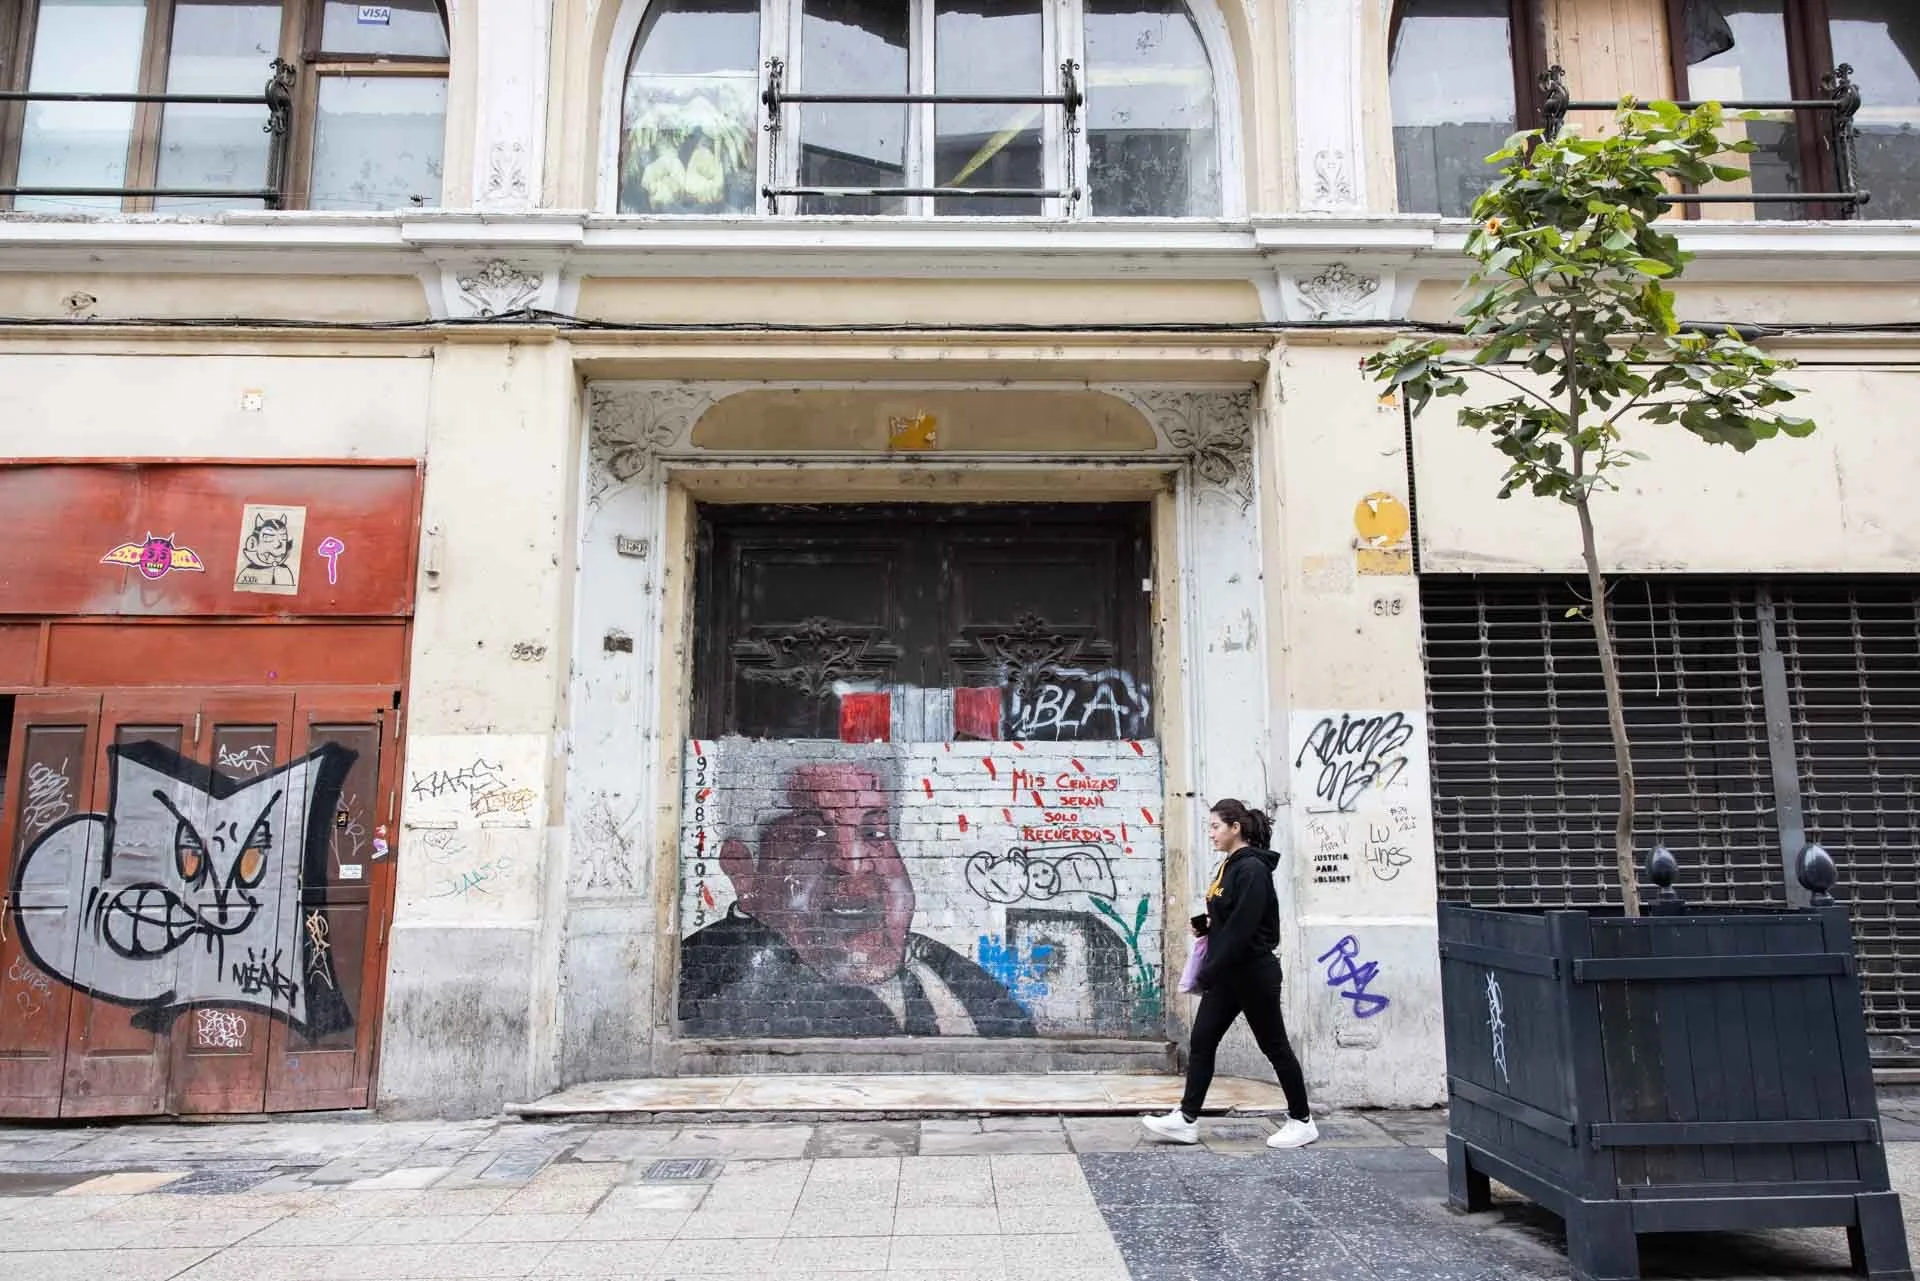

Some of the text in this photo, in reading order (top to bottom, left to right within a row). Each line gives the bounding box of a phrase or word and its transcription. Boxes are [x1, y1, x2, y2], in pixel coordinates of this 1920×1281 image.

[361, 8, 388, 17] VISA
[1044, 812, 1078, 822] SOLO
[1313, 853, 1349, 862] JUSTICIA
